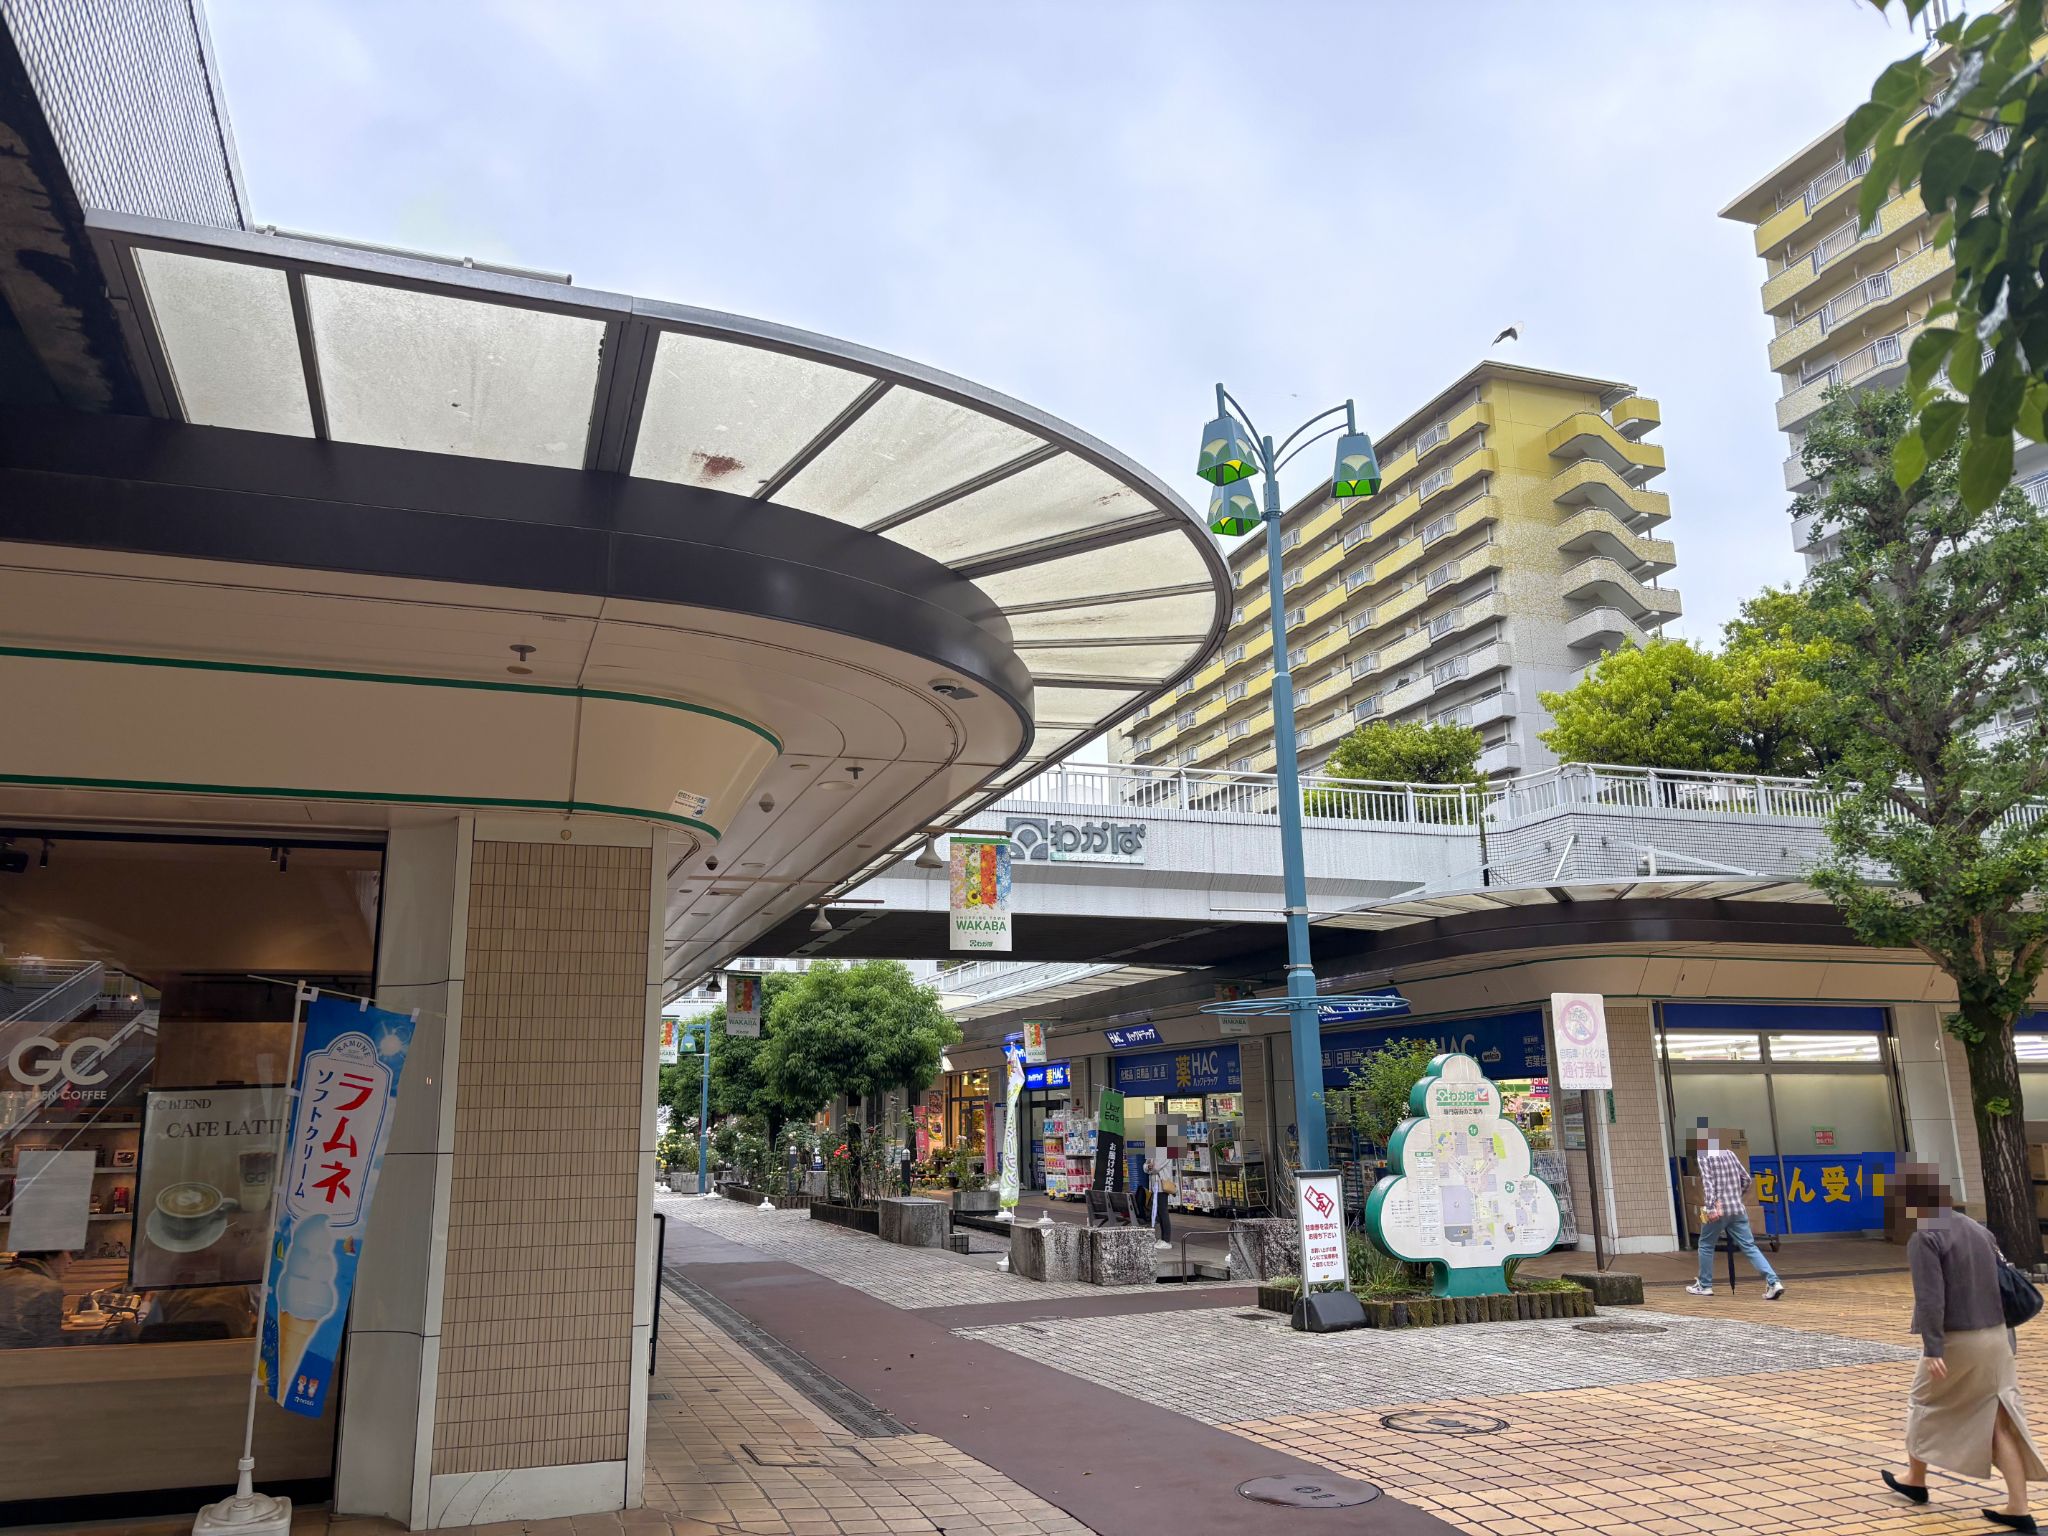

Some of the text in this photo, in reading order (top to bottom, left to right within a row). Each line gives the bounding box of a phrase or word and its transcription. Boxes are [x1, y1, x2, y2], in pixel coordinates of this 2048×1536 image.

[1050, 820, 1147, 854] わかば
[956, 920, 1007, 931] WAKABA
[336, 1040, 372, 1057] RAMUNE
[8, 1036, 109, 1086] GC
[1191, 1050, 1219, 1076] HAC
[1561, 1061, 1609, 1079] 通行禁止
[1052, 1067, 1064, 1079] HAC
[61, 1090, 107, 1100] COFFEE
[168, 1098, 212, 1110] BLEND
[1105, 1101, 1120, 1113] Uber
[1104, 1111, 1120, 1123] Eats
[166, 1120, 220, 1138] CAFE
[294, 1069, 334, 1199] ソフトクリーム
[311, 1072, 374, 1204] ラムネ
[1751, 1163, 1883, 1203] せん受
